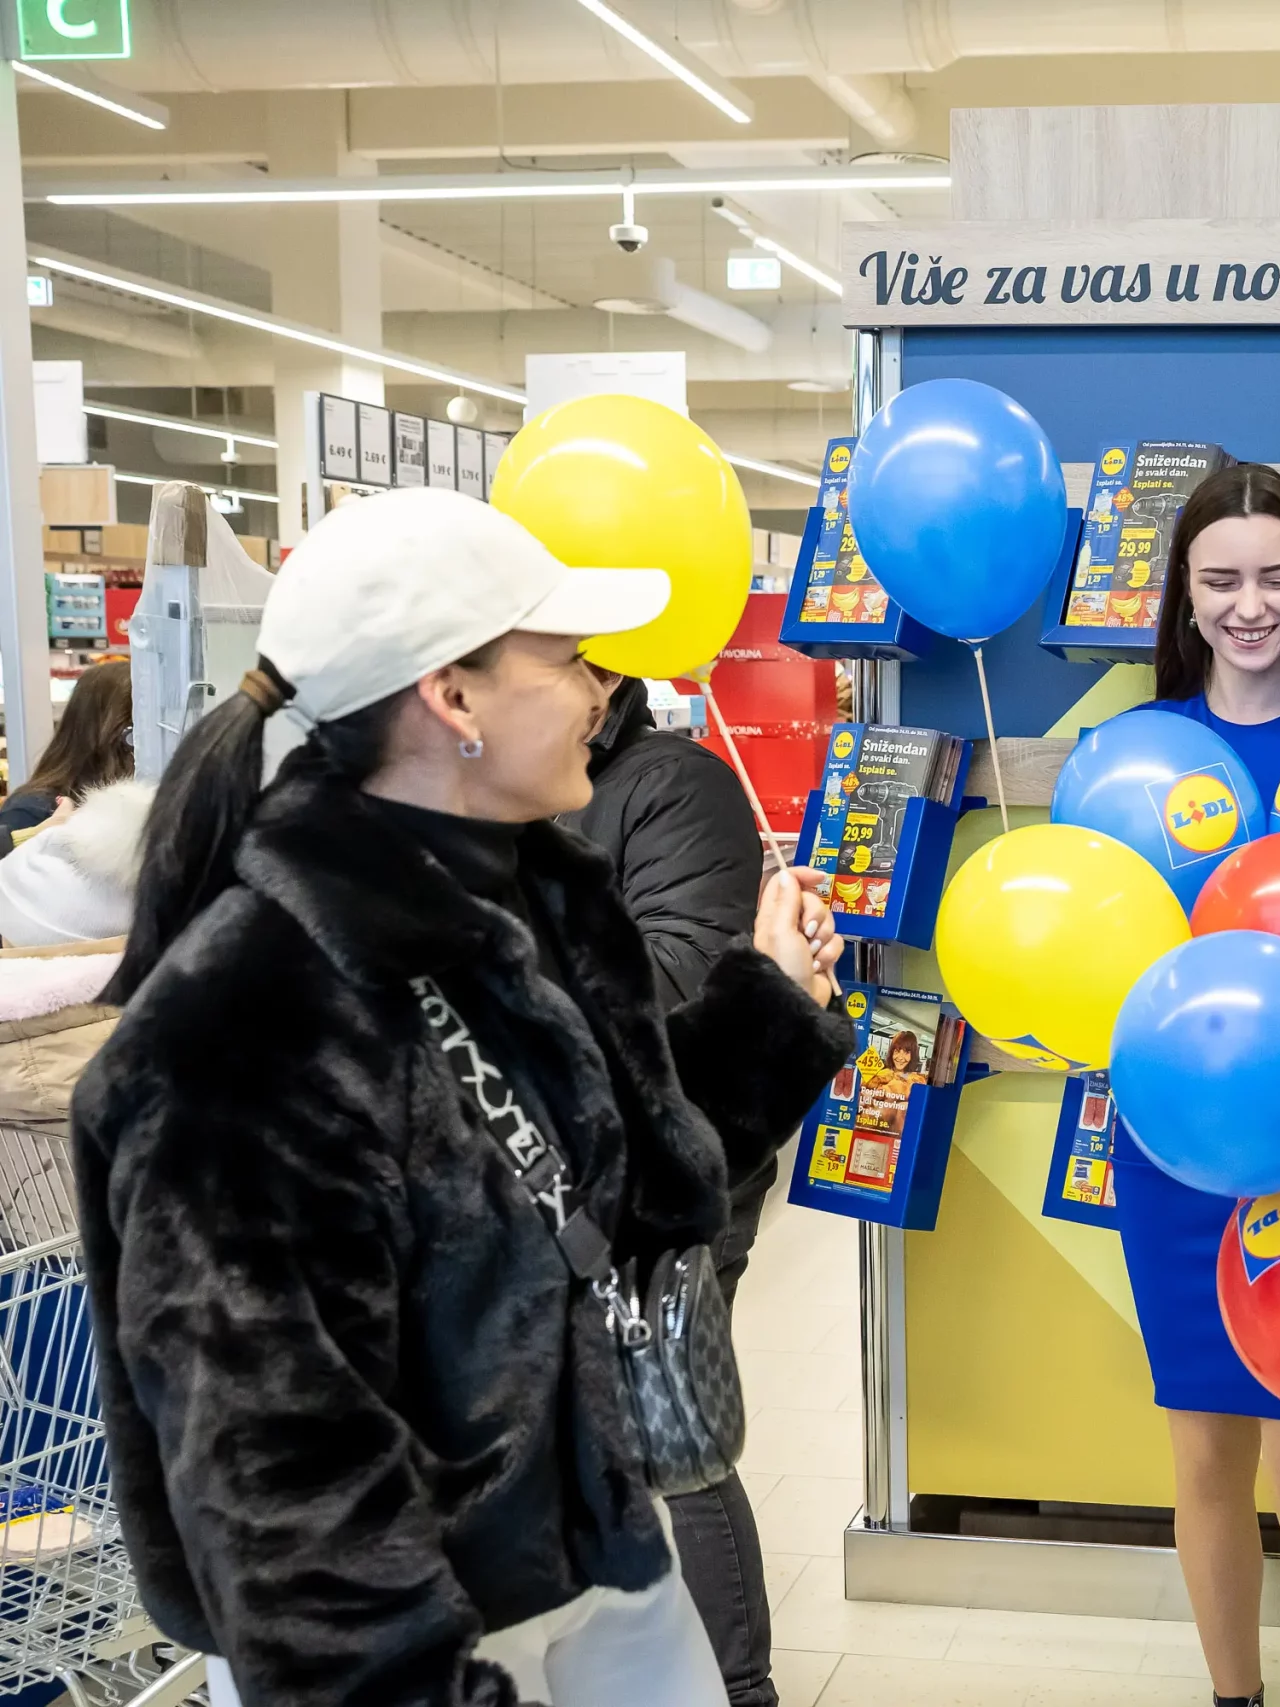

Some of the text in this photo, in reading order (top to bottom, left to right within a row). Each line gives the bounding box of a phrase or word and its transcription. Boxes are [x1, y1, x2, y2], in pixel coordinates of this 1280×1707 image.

[859, 250, 969, 306] Više
[983, 265, 1048, 305] za
[1060, 262, 1152, 304] vas
[1165, 263, 1201, 302] u
[1136, 453, 1208, 469] Snižendan
[1134, 468, 1189, 478] je svaki dan.
[1133, 480, 1162, 490] Isplati
[1118, 541, 1152, 558] 29.99
[862, 738, 928, 757] Snižendan
[860, 753, 911, 765] je svaki dan.
[858, 764, 897, 776] Isplati se.
[842, 825, 873, 842] 29.99
[857, 1056, 882, 1068] -45%
[861, 1086, 905, 1101] Posjeti novu
[858, 1106, 883, 1119] Prelog.
[856, 1114, 879, 1127] Isplati
